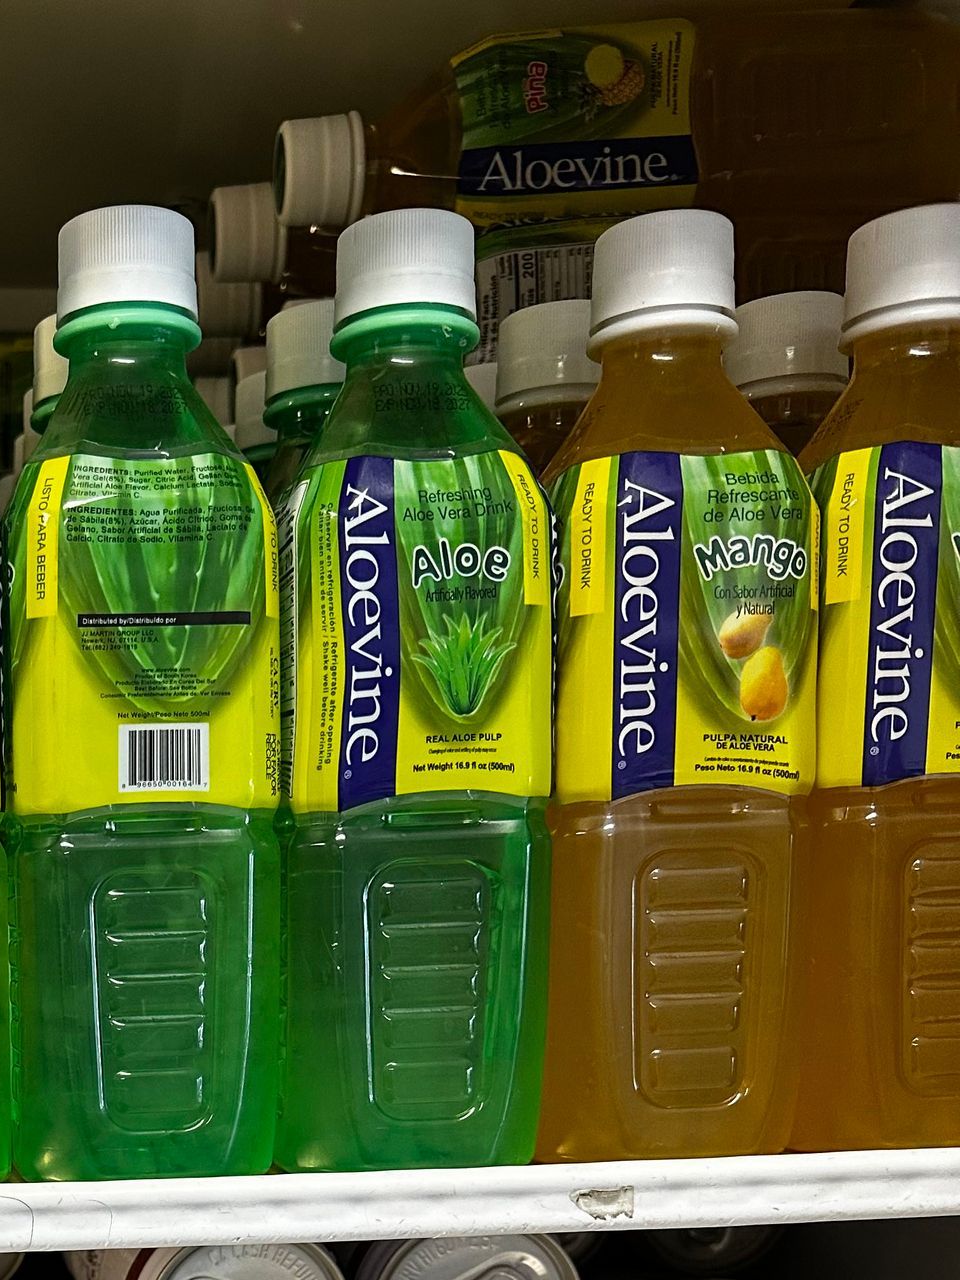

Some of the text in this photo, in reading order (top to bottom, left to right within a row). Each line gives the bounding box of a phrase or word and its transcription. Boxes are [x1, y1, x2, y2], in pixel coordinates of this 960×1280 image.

[476, 147, 669, 192] Aloevine
[522, 252, 535, 279] 200
[725, 472, 779, 485] Bebida
[418, 486, 491, 502] Refreshing
[707, 489, 799, 505] Refrescante
[403, 500, 513, 522] Aloe Vera Drink
[703, 507, 802, 523] de Aloe Vera
[516, 474, 540, 579] READY TO DRINK
[580, 482, 596, 589] READY TO DRINK
[837, 473, 854, 578] READY TO DRINK
[36, 477, 55, 600] LISTO PARA BEBER
[411, 538, 512, 589] Aloe
[694, 534, 807, 582] Mango
[426, 587, 497, 602] Artificially Flavored
[714, 584, 795, 599] Con Sabor Artificial
[870, 467, 935, 743] Aloevine
[344, 483, 393, 766] Aloevine
[618, 478, 676, 757] Aloevine
[425, 733, 502, 744] REAL ALOE PULP
[703, 734, 788, 744] PULPA NATURAL
[716, 742, 775, 752] DE ALOE VERA
[694, 764, 715, 773] Peso
[716, 763, 735, 772] Neto
[737, 765, 753, 774] 16.9
[772, 769, 799, 781] (500ml)
